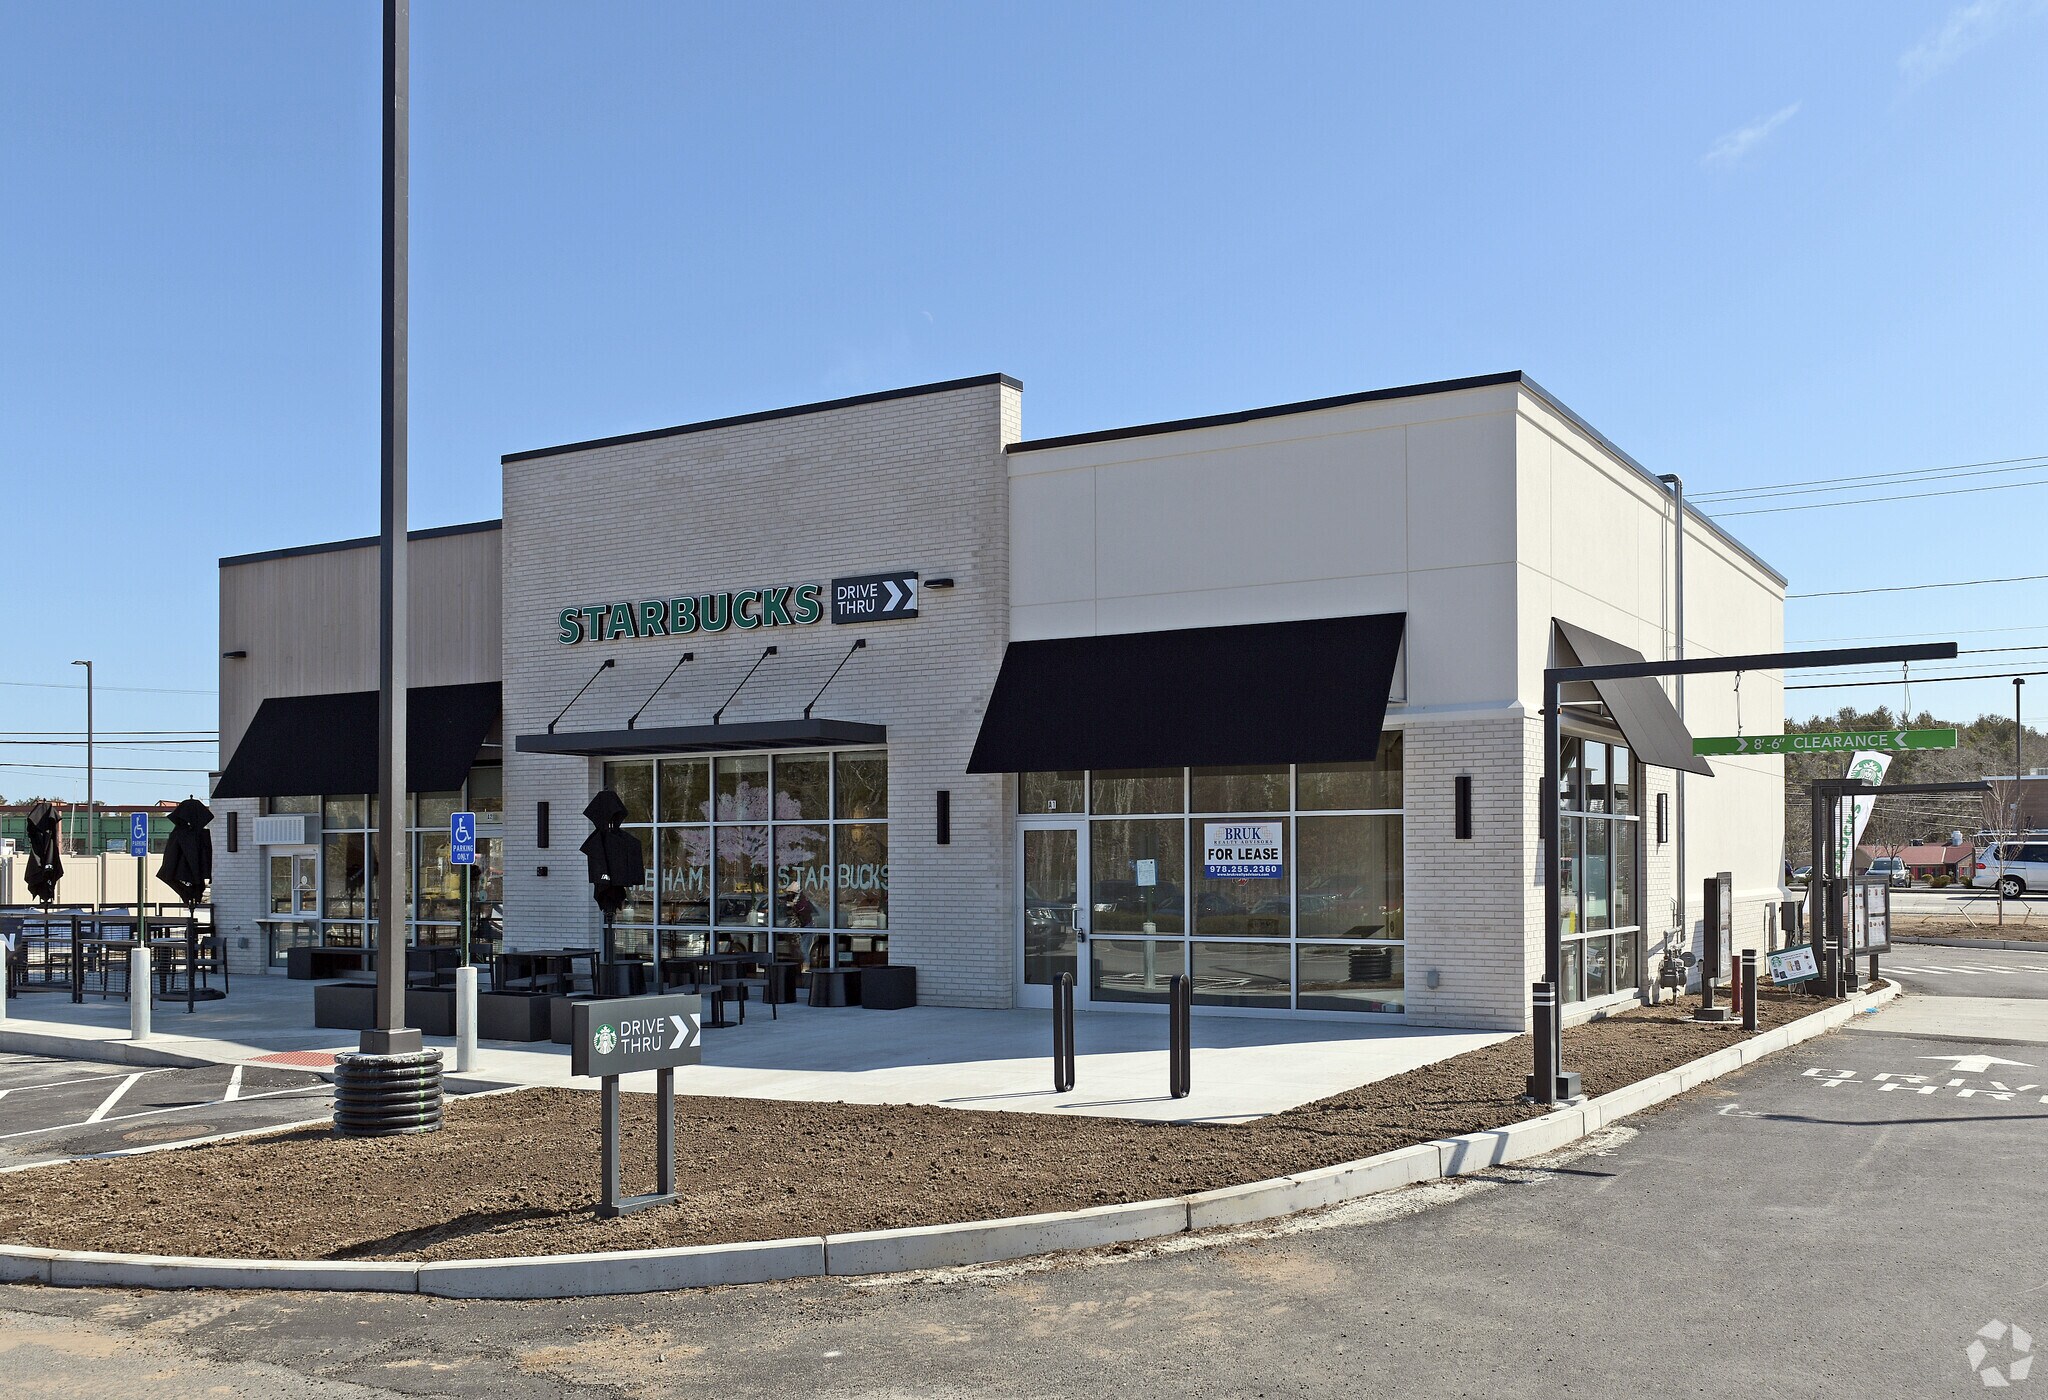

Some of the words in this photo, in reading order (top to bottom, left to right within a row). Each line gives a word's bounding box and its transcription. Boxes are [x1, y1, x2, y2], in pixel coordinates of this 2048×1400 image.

[837, 583, 878, 600] DRIVE
[558, 583, 821, 645] STARBUCKS
[837, 599, 875, 615] THRU
[1793, 734, 1888, 749] CLEARANCE
[1225, 827, 1261, 840] BRUK
[453, 844, 473, 852] PARKING
[1208, 848, 1233, 860] FOR
[1238, 847, 1279, 860] LEASE
[456, 853, 470, 861] ONLY
[1209, 865, 1277, 873] 978.255.2360
[777, 863, 889, 892] STARBUCKS
[620, 1017, 665, 1037] DRIVE
[620, 1035, 662, 1055] THRU
[1800, 1067, 2041, 1092] DRIV
